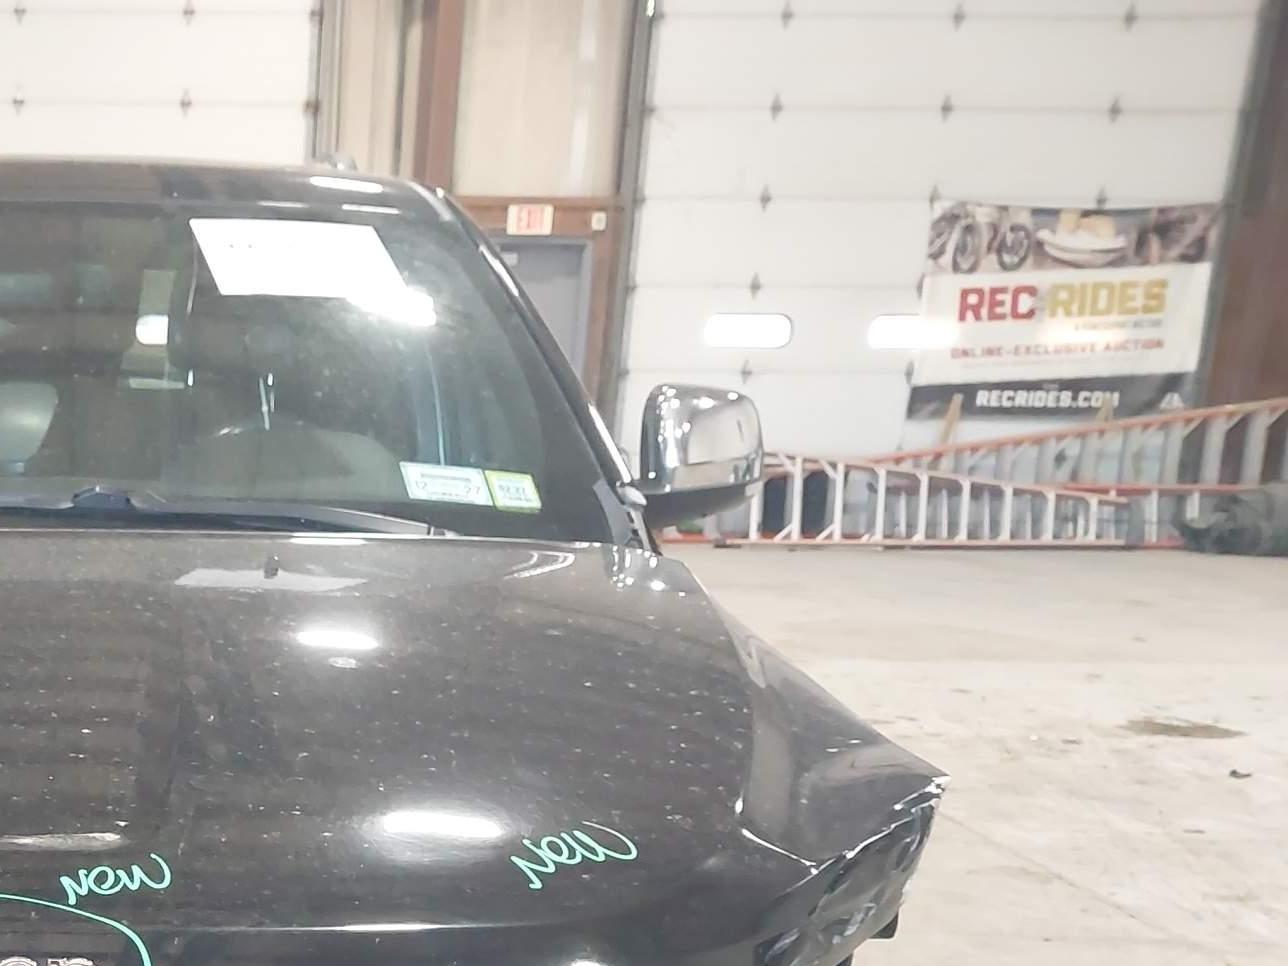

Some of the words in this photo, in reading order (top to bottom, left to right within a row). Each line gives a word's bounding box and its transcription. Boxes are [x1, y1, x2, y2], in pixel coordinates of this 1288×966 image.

[958, 286, 1038, 322] REC
[1047, 279, 1169, 318] RIDES
[1103, 338, 1164, 352] AUCTION
